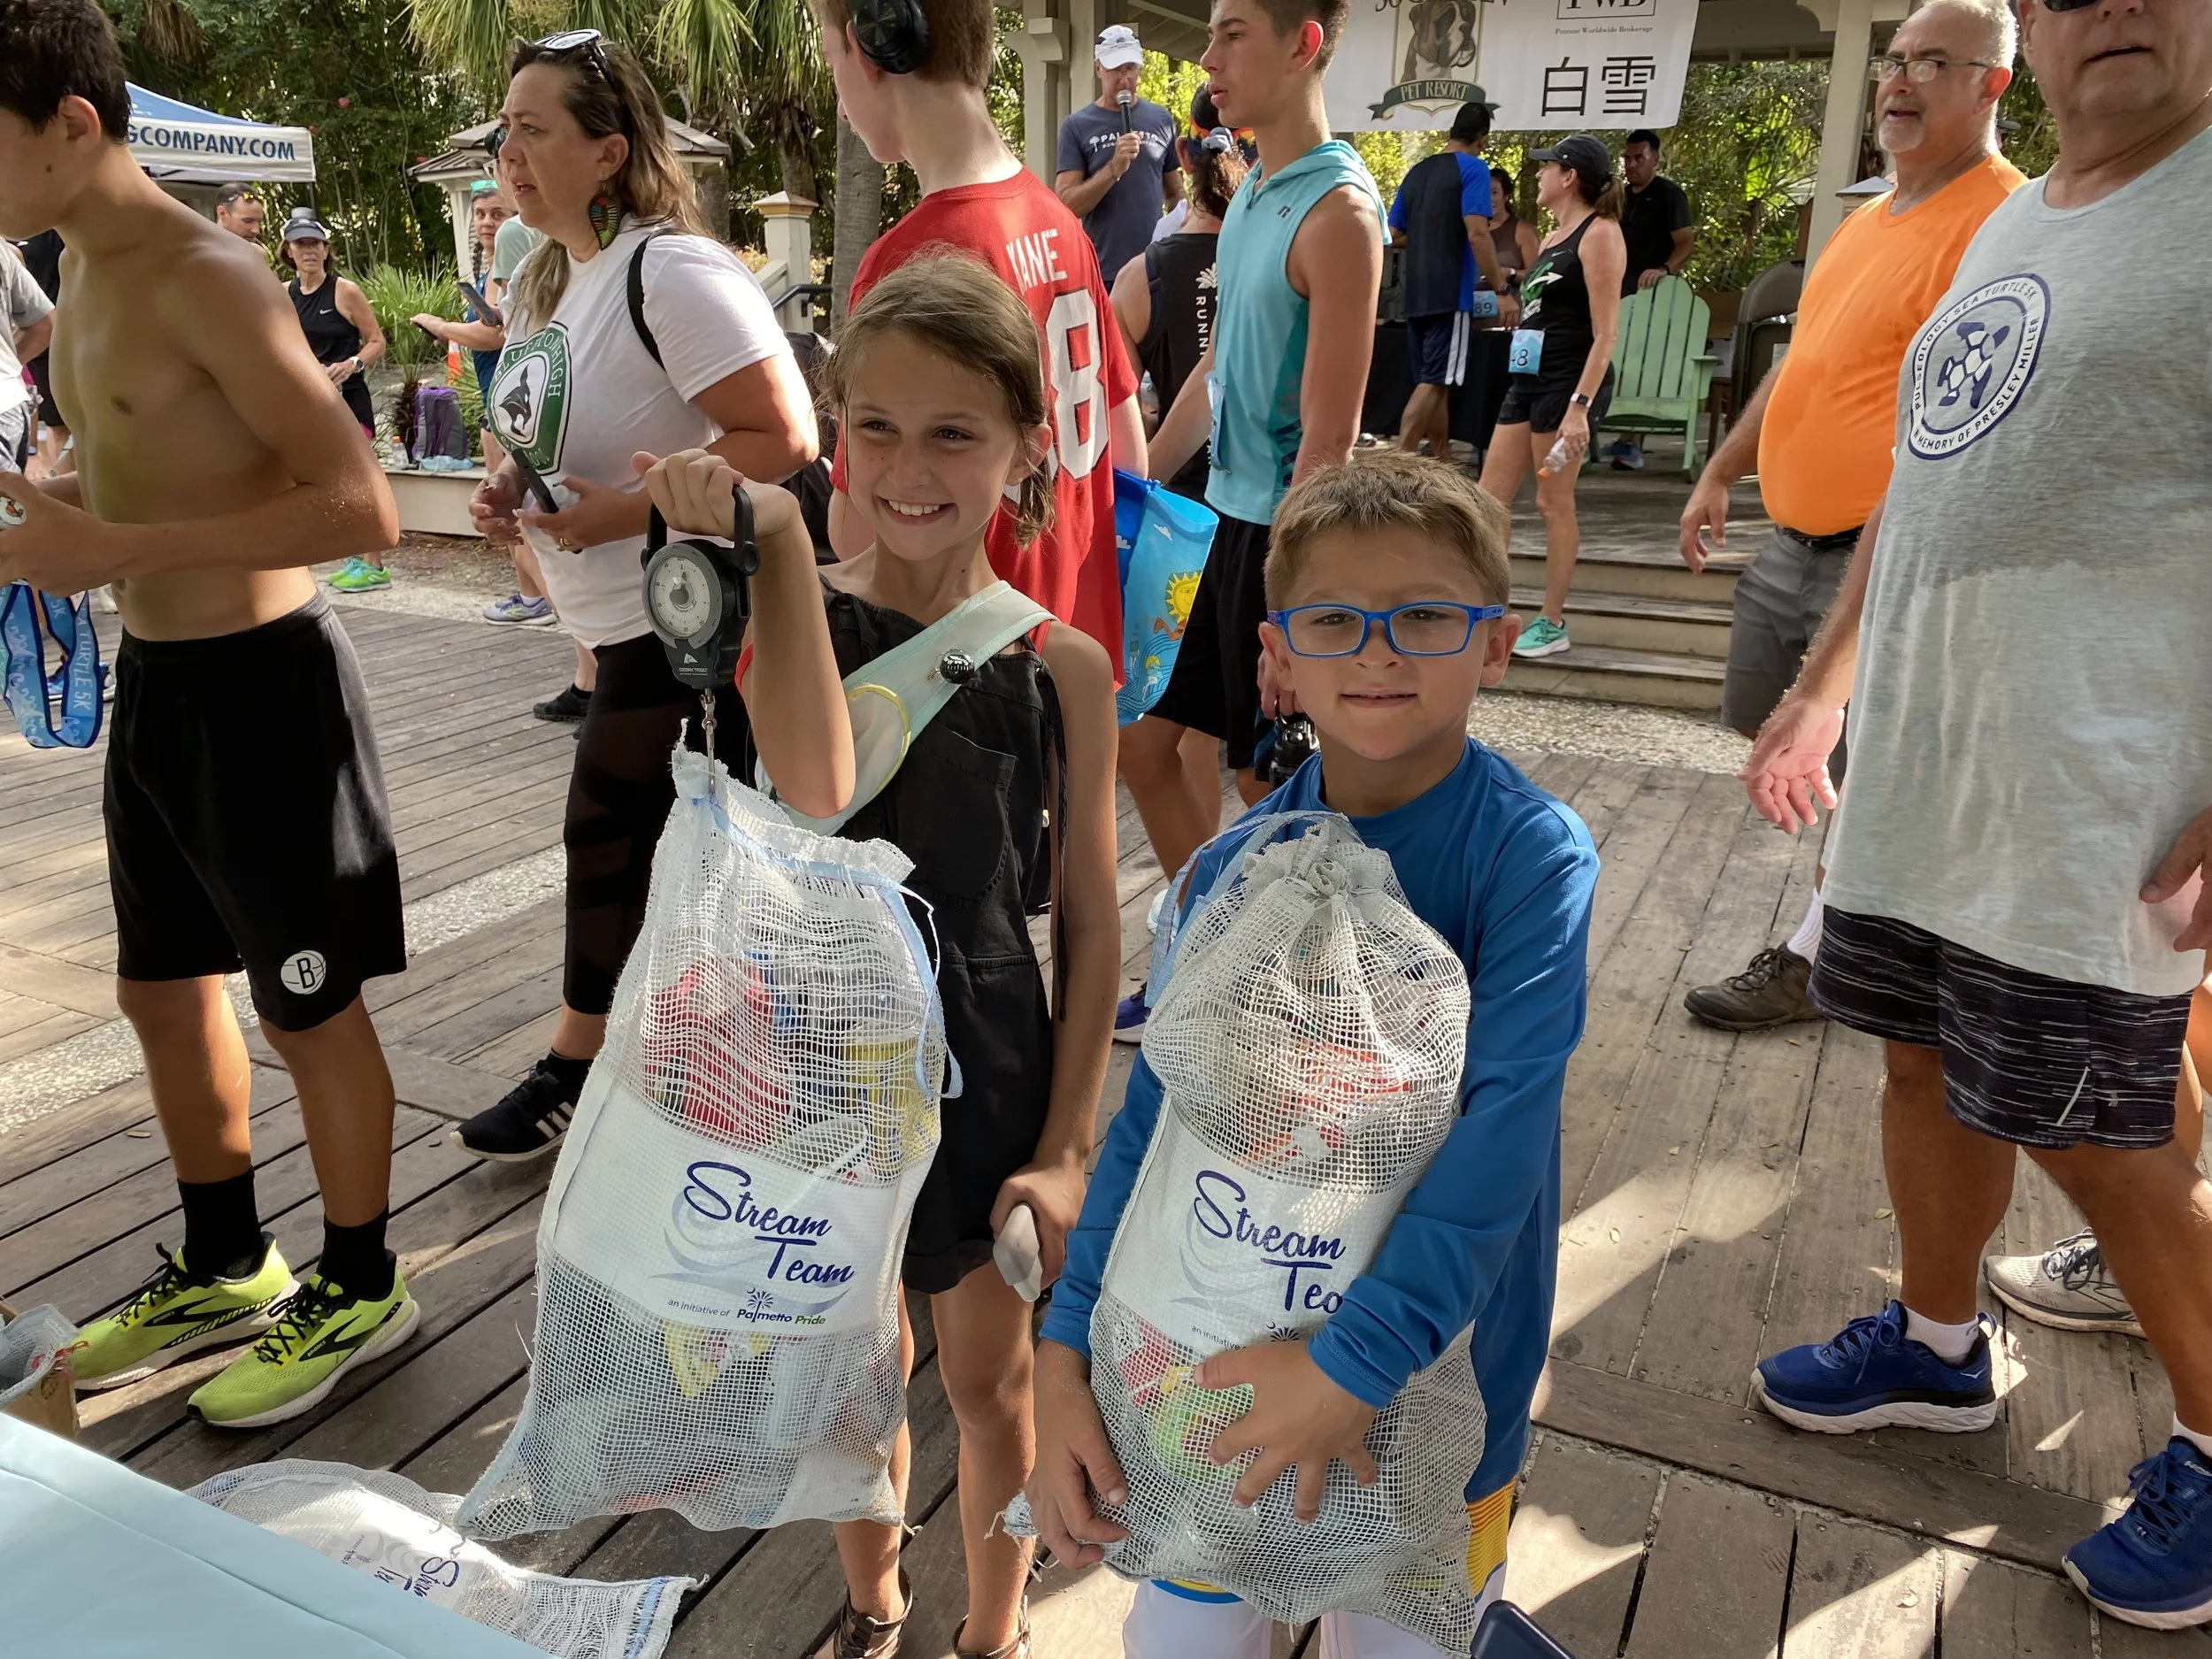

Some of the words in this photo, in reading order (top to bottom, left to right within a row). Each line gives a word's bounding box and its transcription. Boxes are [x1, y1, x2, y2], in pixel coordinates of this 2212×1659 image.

[1618, 25, 1654, 34] Brokerage
[1401, 82, 1422, 102] PET
[1425, 81, 1470, 98] RESORT
[1541, 56, 1656, 117] 白雪
[1954, 296, 1978, 315] SEA
[1985, 282, 2027, 297] TURTLE
[2024, 286, 2038, 301] 5K
[548, 346, 564, 398] HIGH
[1918, 436, 1955, 450] MEMORY
[1958, 429, 1971, 442] OF
[1976, 373, 2021, 431] PRESLEY
[2018, 316, 2039, 370] MILLER
[50, 599, 66, 619] 5K
[73, 632, 92, 688] TURTLE
[73, 692, 92, 711] 5K
[296, 957, 316, 989] B
[683, 1161, 832, 1236] Stream
[1194, 1170, 1347, 1260] Stream
[754, 1235, 855, 1284] Team
[680, 1301, 719, 1317] initiative
[736, 1303, 793, 1323] Palmetto
[795, 1315, 826, 1325] Pride
[1191, 1325, 1202, 1335] an
[1202, 1331, 1241, 1351] initiative
